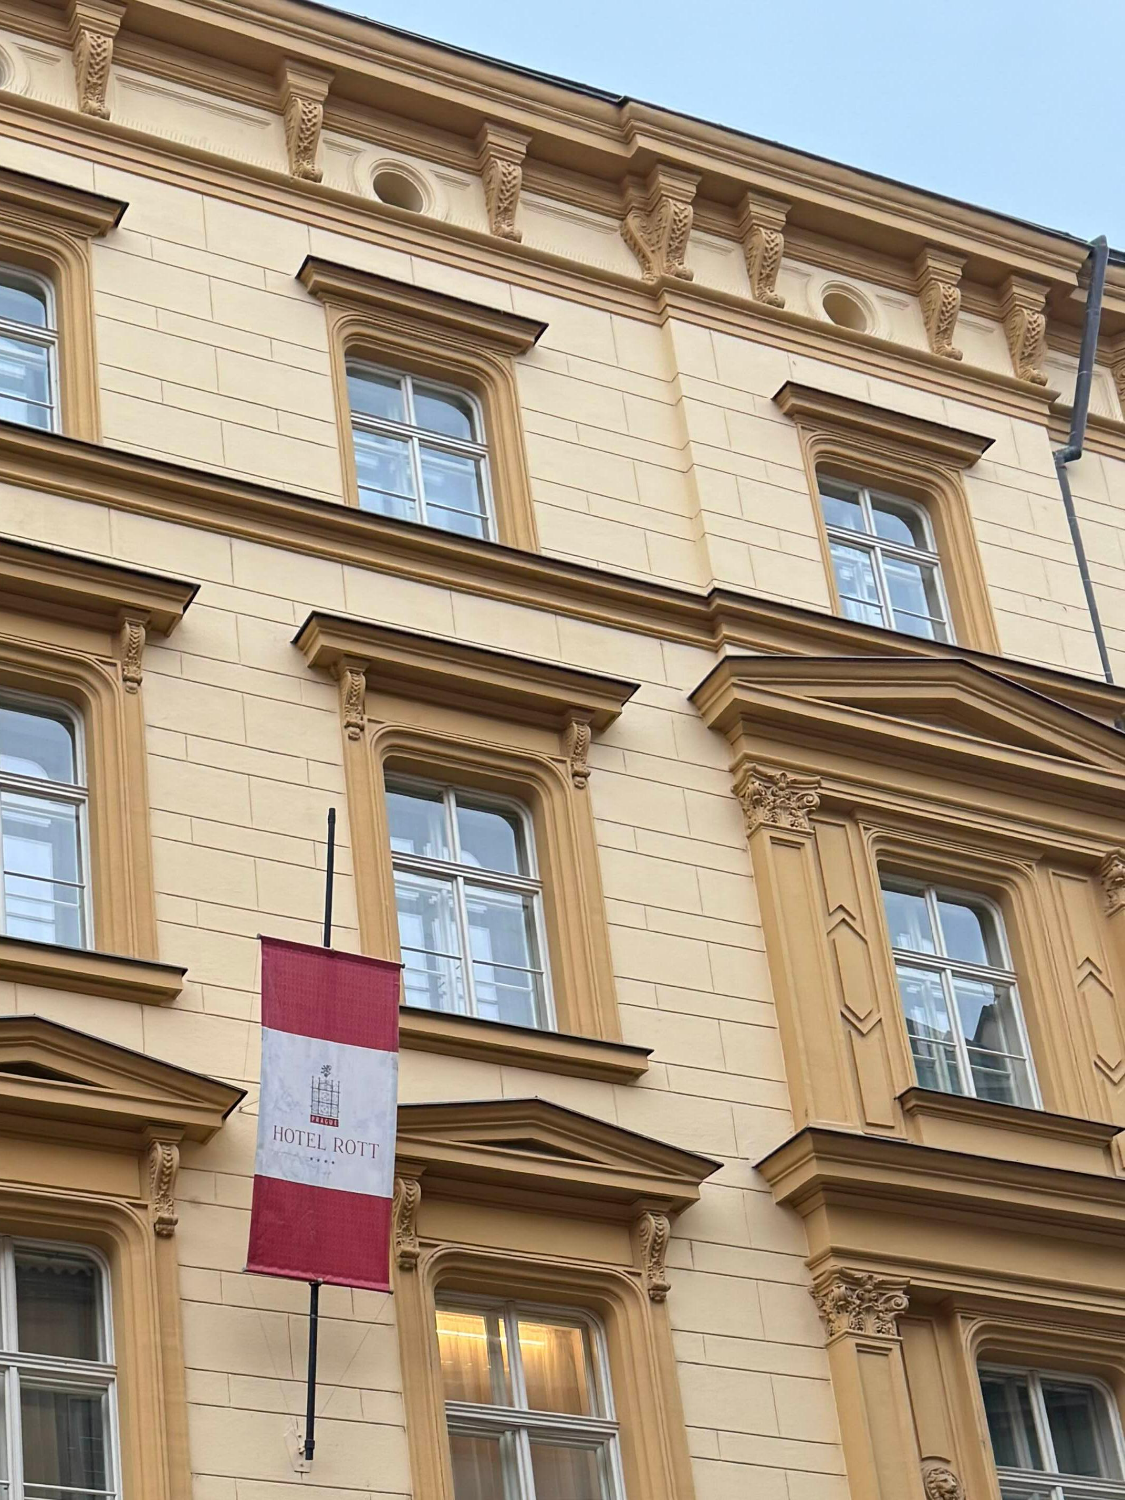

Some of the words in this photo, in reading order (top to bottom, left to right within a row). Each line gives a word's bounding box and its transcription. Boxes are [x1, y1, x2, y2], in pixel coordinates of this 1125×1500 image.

[311, 1115, 338, 1127] PRAGUE
[273, 1125, 327, 1151] HOTEL
[333, 1137, 380, 1159] ROTT
